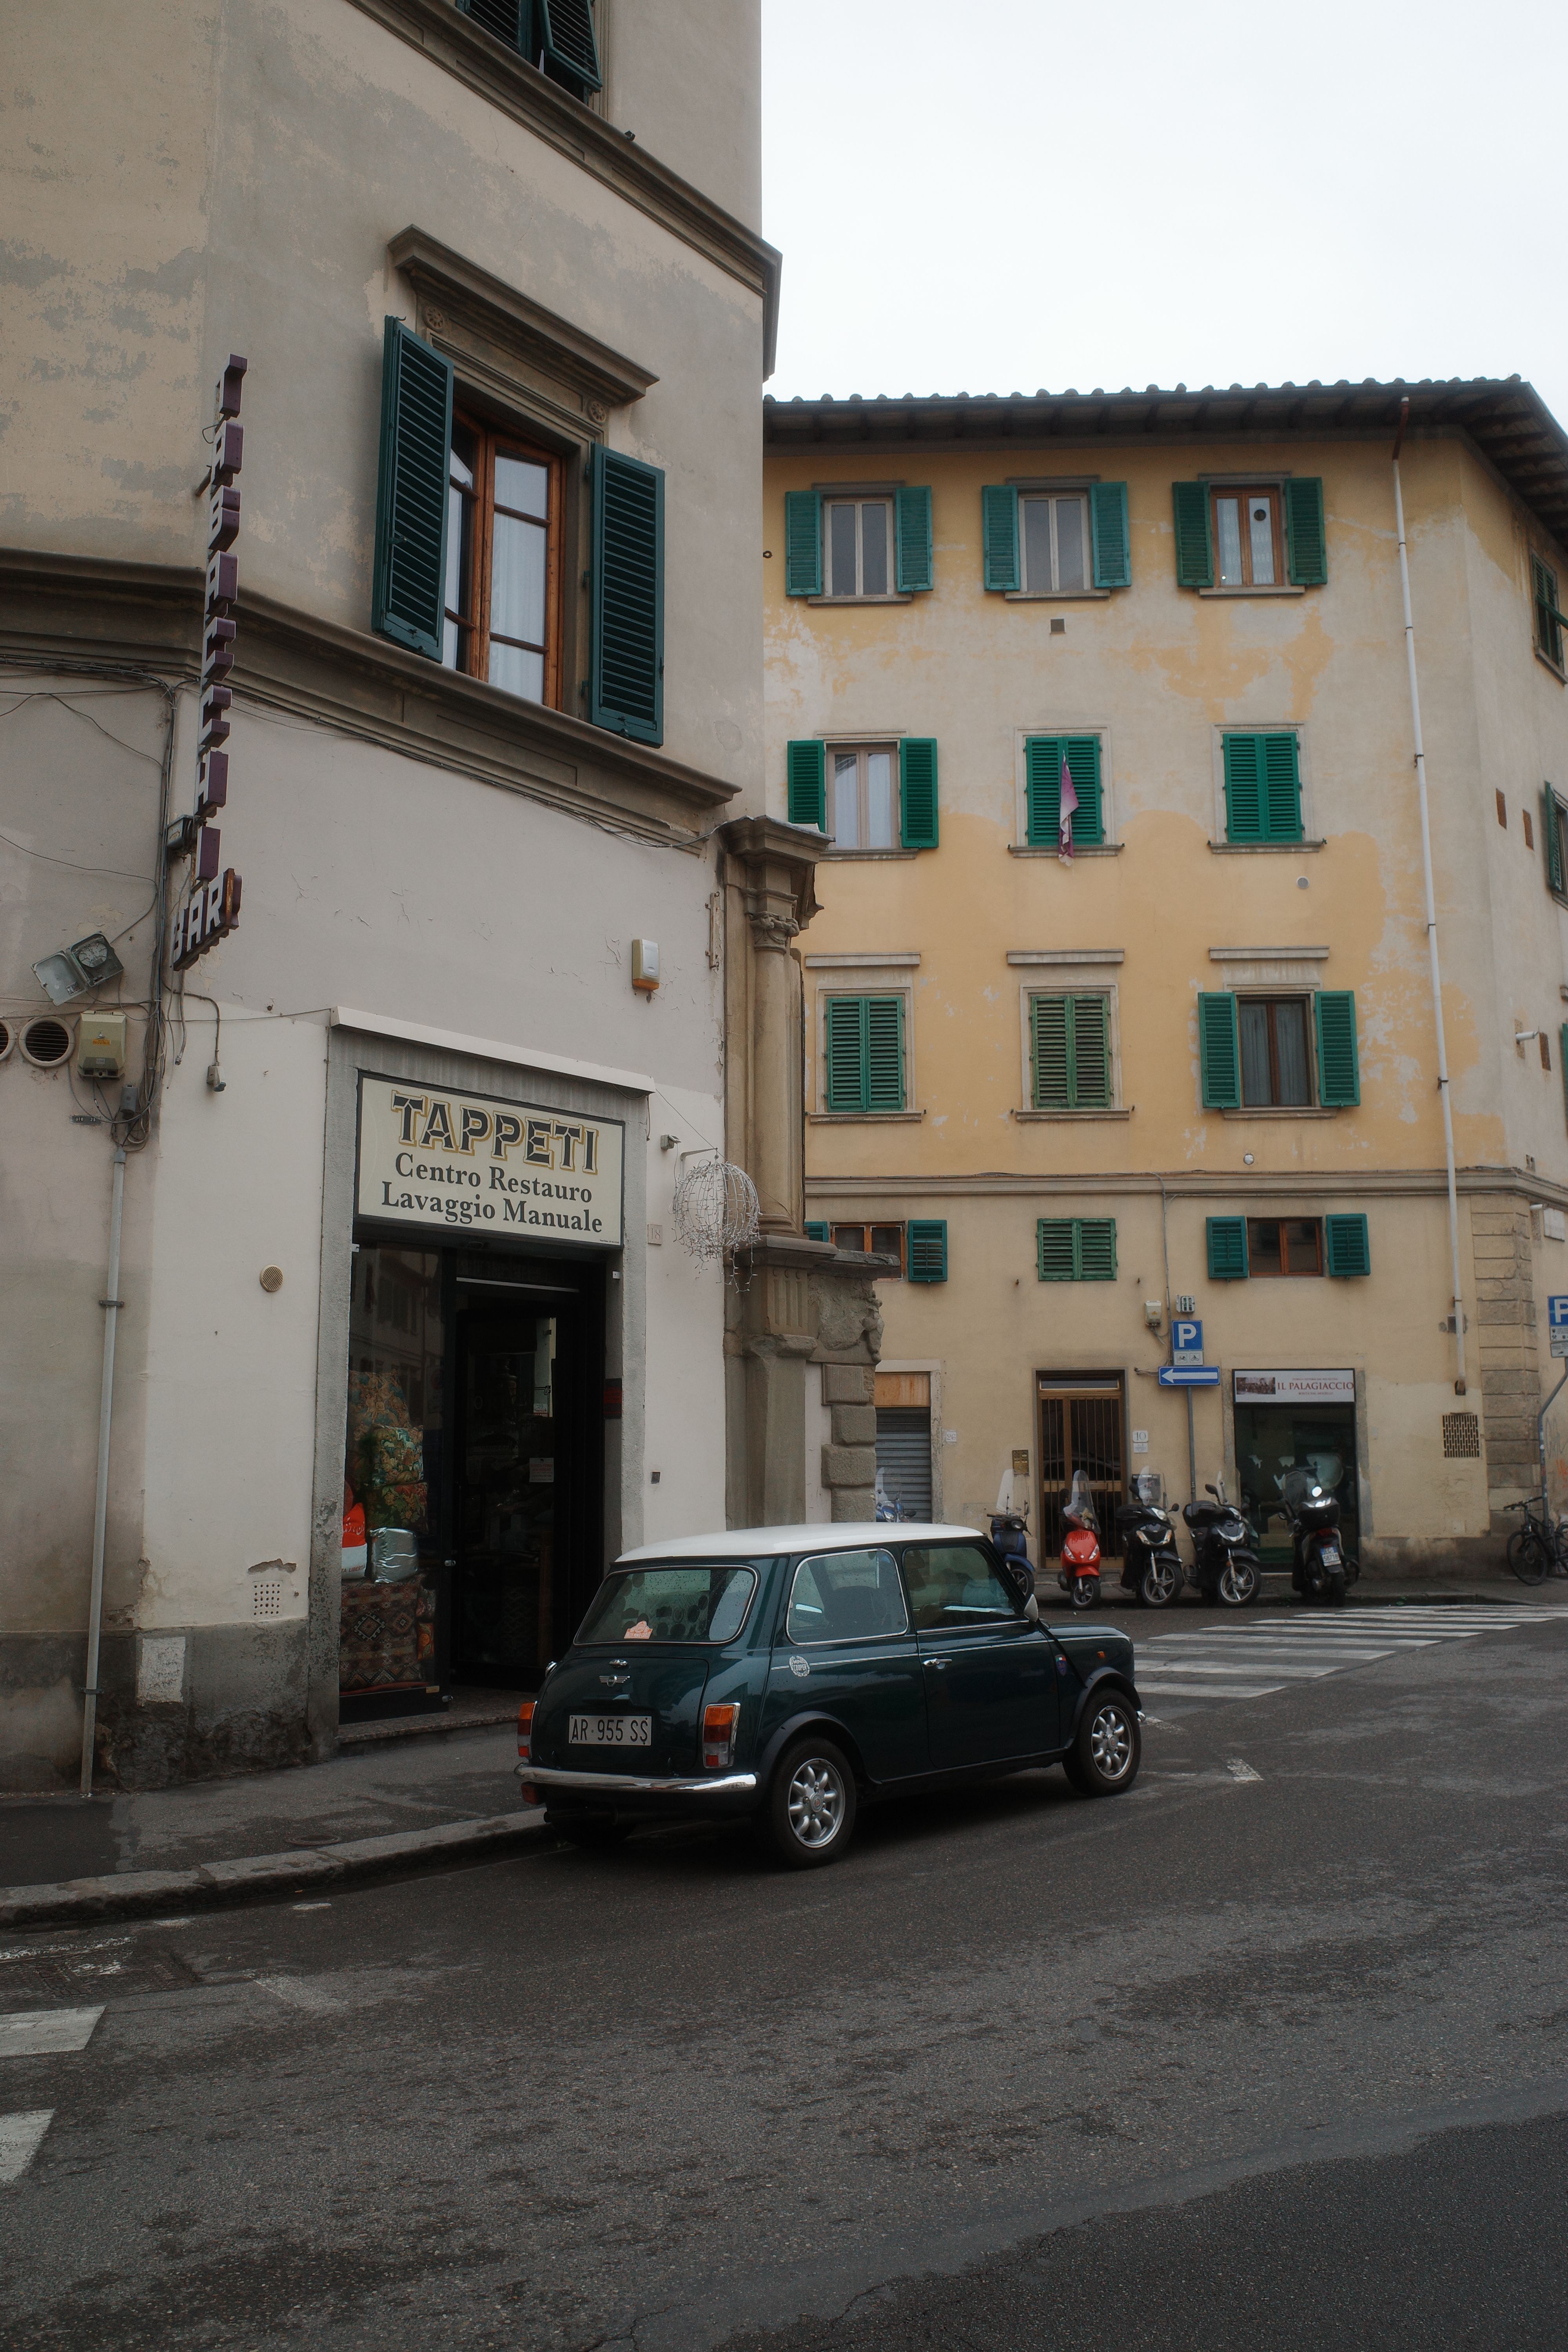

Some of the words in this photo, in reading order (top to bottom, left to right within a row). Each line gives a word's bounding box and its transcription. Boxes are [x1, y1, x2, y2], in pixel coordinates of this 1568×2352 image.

[170, 869, 240, 970] BAR
[391, 1090, 599, 1175] TAPPETI
[396, 1152, 481, 1187] Centro
[489, 1166, 592, 1203] Restauro
[382, 1181, 495, 1224] Lavaggio
[503, 1198, 603, 1232] Manuale
[652, 1228, 661, 1240] 18
[1554, 1299, 1568, 1323] P
[1178, 1323, 1197, 1348] P
[1134, 1432, 1146, 1441] 10
[572, 1719, 588, 1740] AR
[597, 1719, 624, 1741] 955
[630, 1720, 648, 1742] SS
